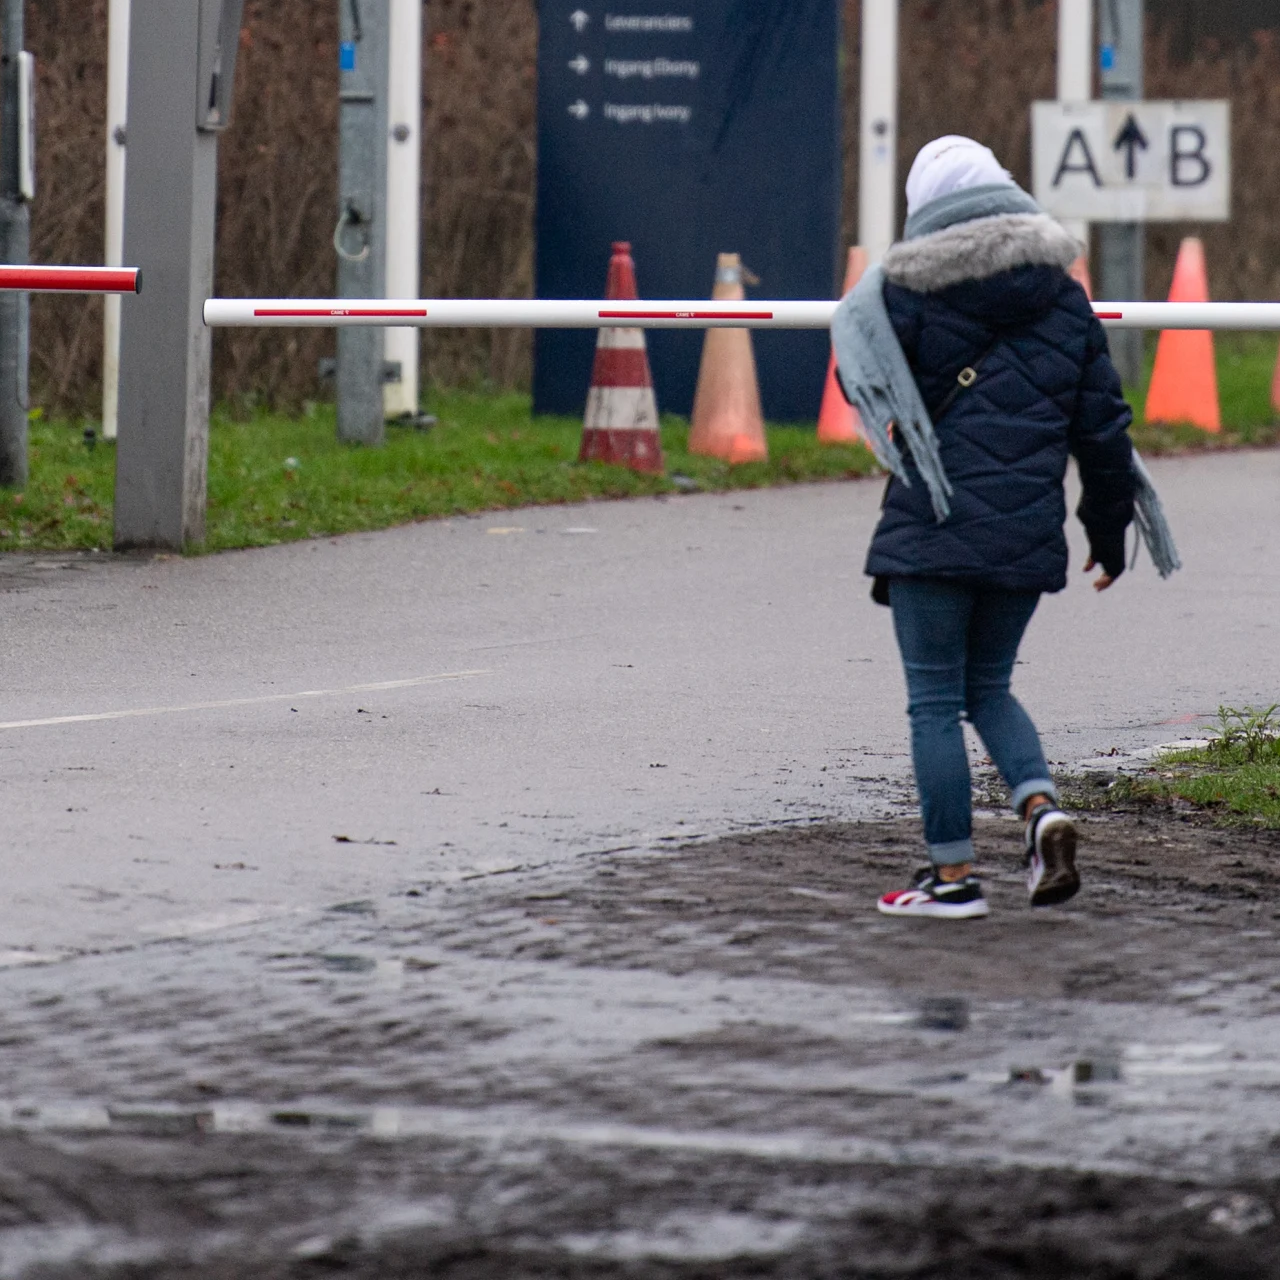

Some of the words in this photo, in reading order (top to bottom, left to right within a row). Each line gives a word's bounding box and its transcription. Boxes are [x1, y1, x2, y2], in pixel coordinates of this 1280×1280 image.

[605, 60, 652, 79] Ingang
[604, 104, 652, 123] Ingang
[1051, 126, 1103, 188] A
[1168, 124, 1212, 188] B
